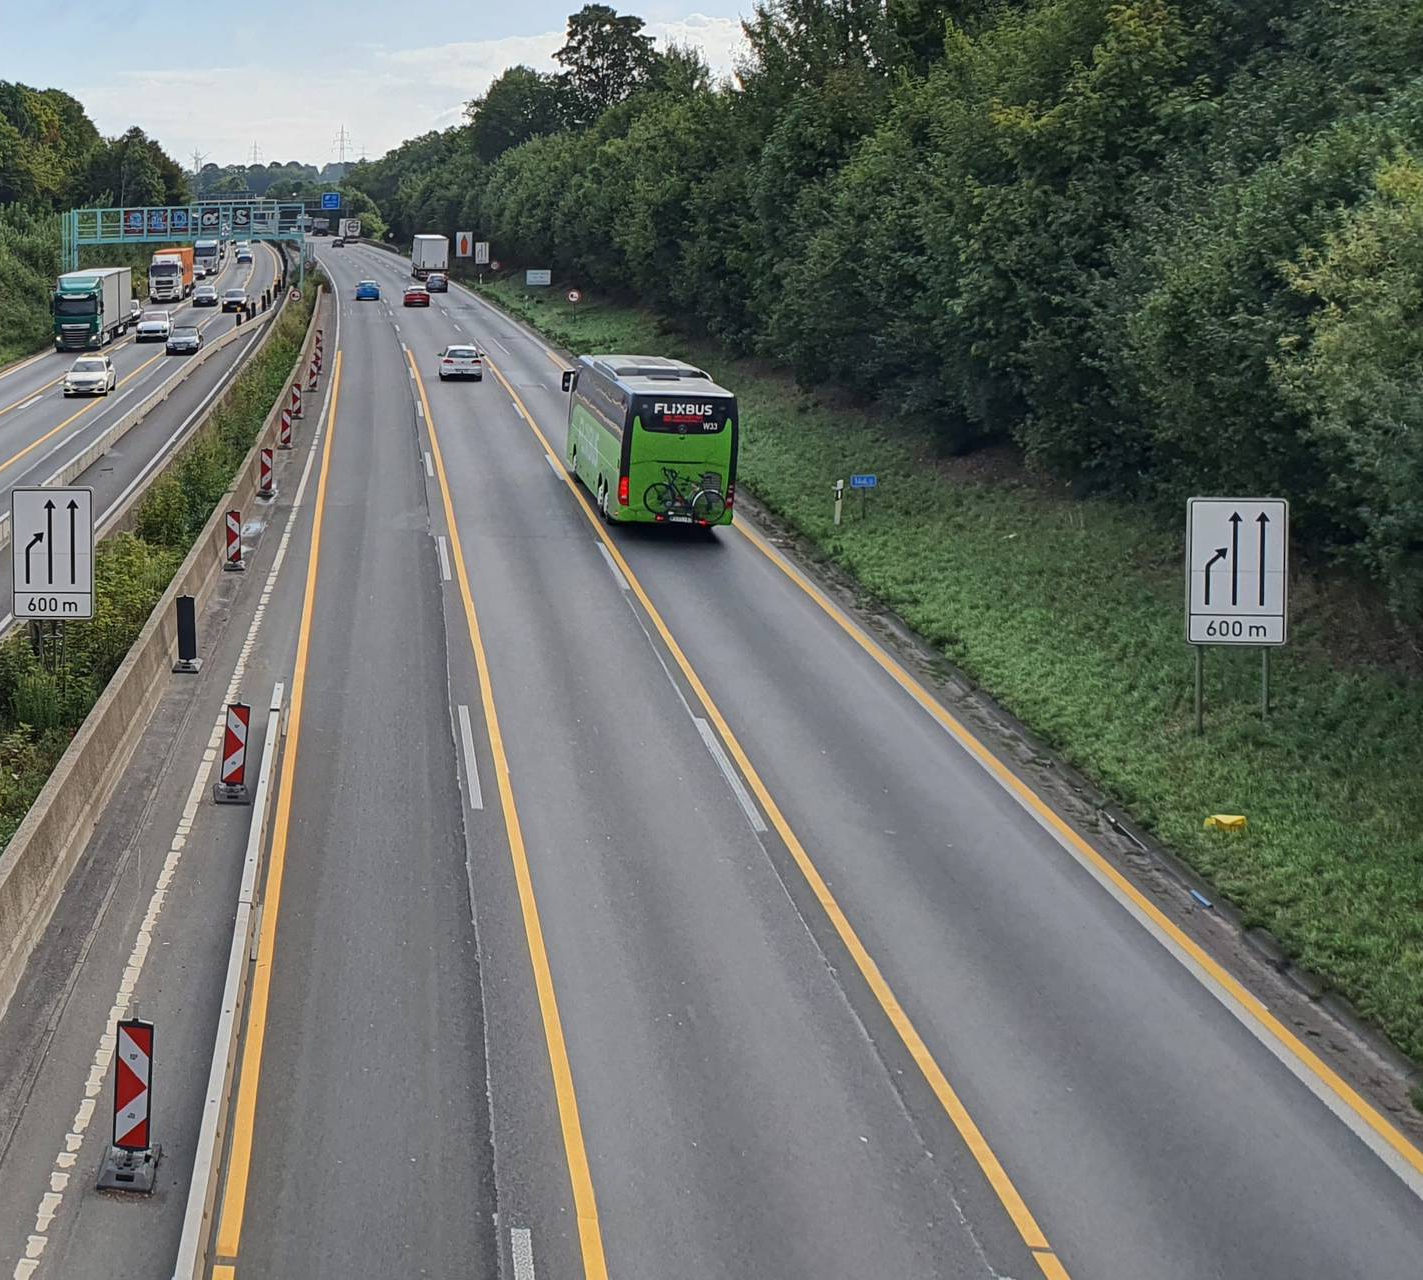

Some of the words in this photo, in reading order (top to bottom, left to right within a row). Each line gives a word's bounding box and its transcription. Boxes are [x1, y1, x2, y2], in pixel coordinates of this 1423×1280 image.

[703, 422, 718, 431] W33
[28, 597, 58, 612] 600
[63, 601, 78, 612] m
[1206, 620, 1243, 637] 600
[1248, 625, 1267, 637] m
